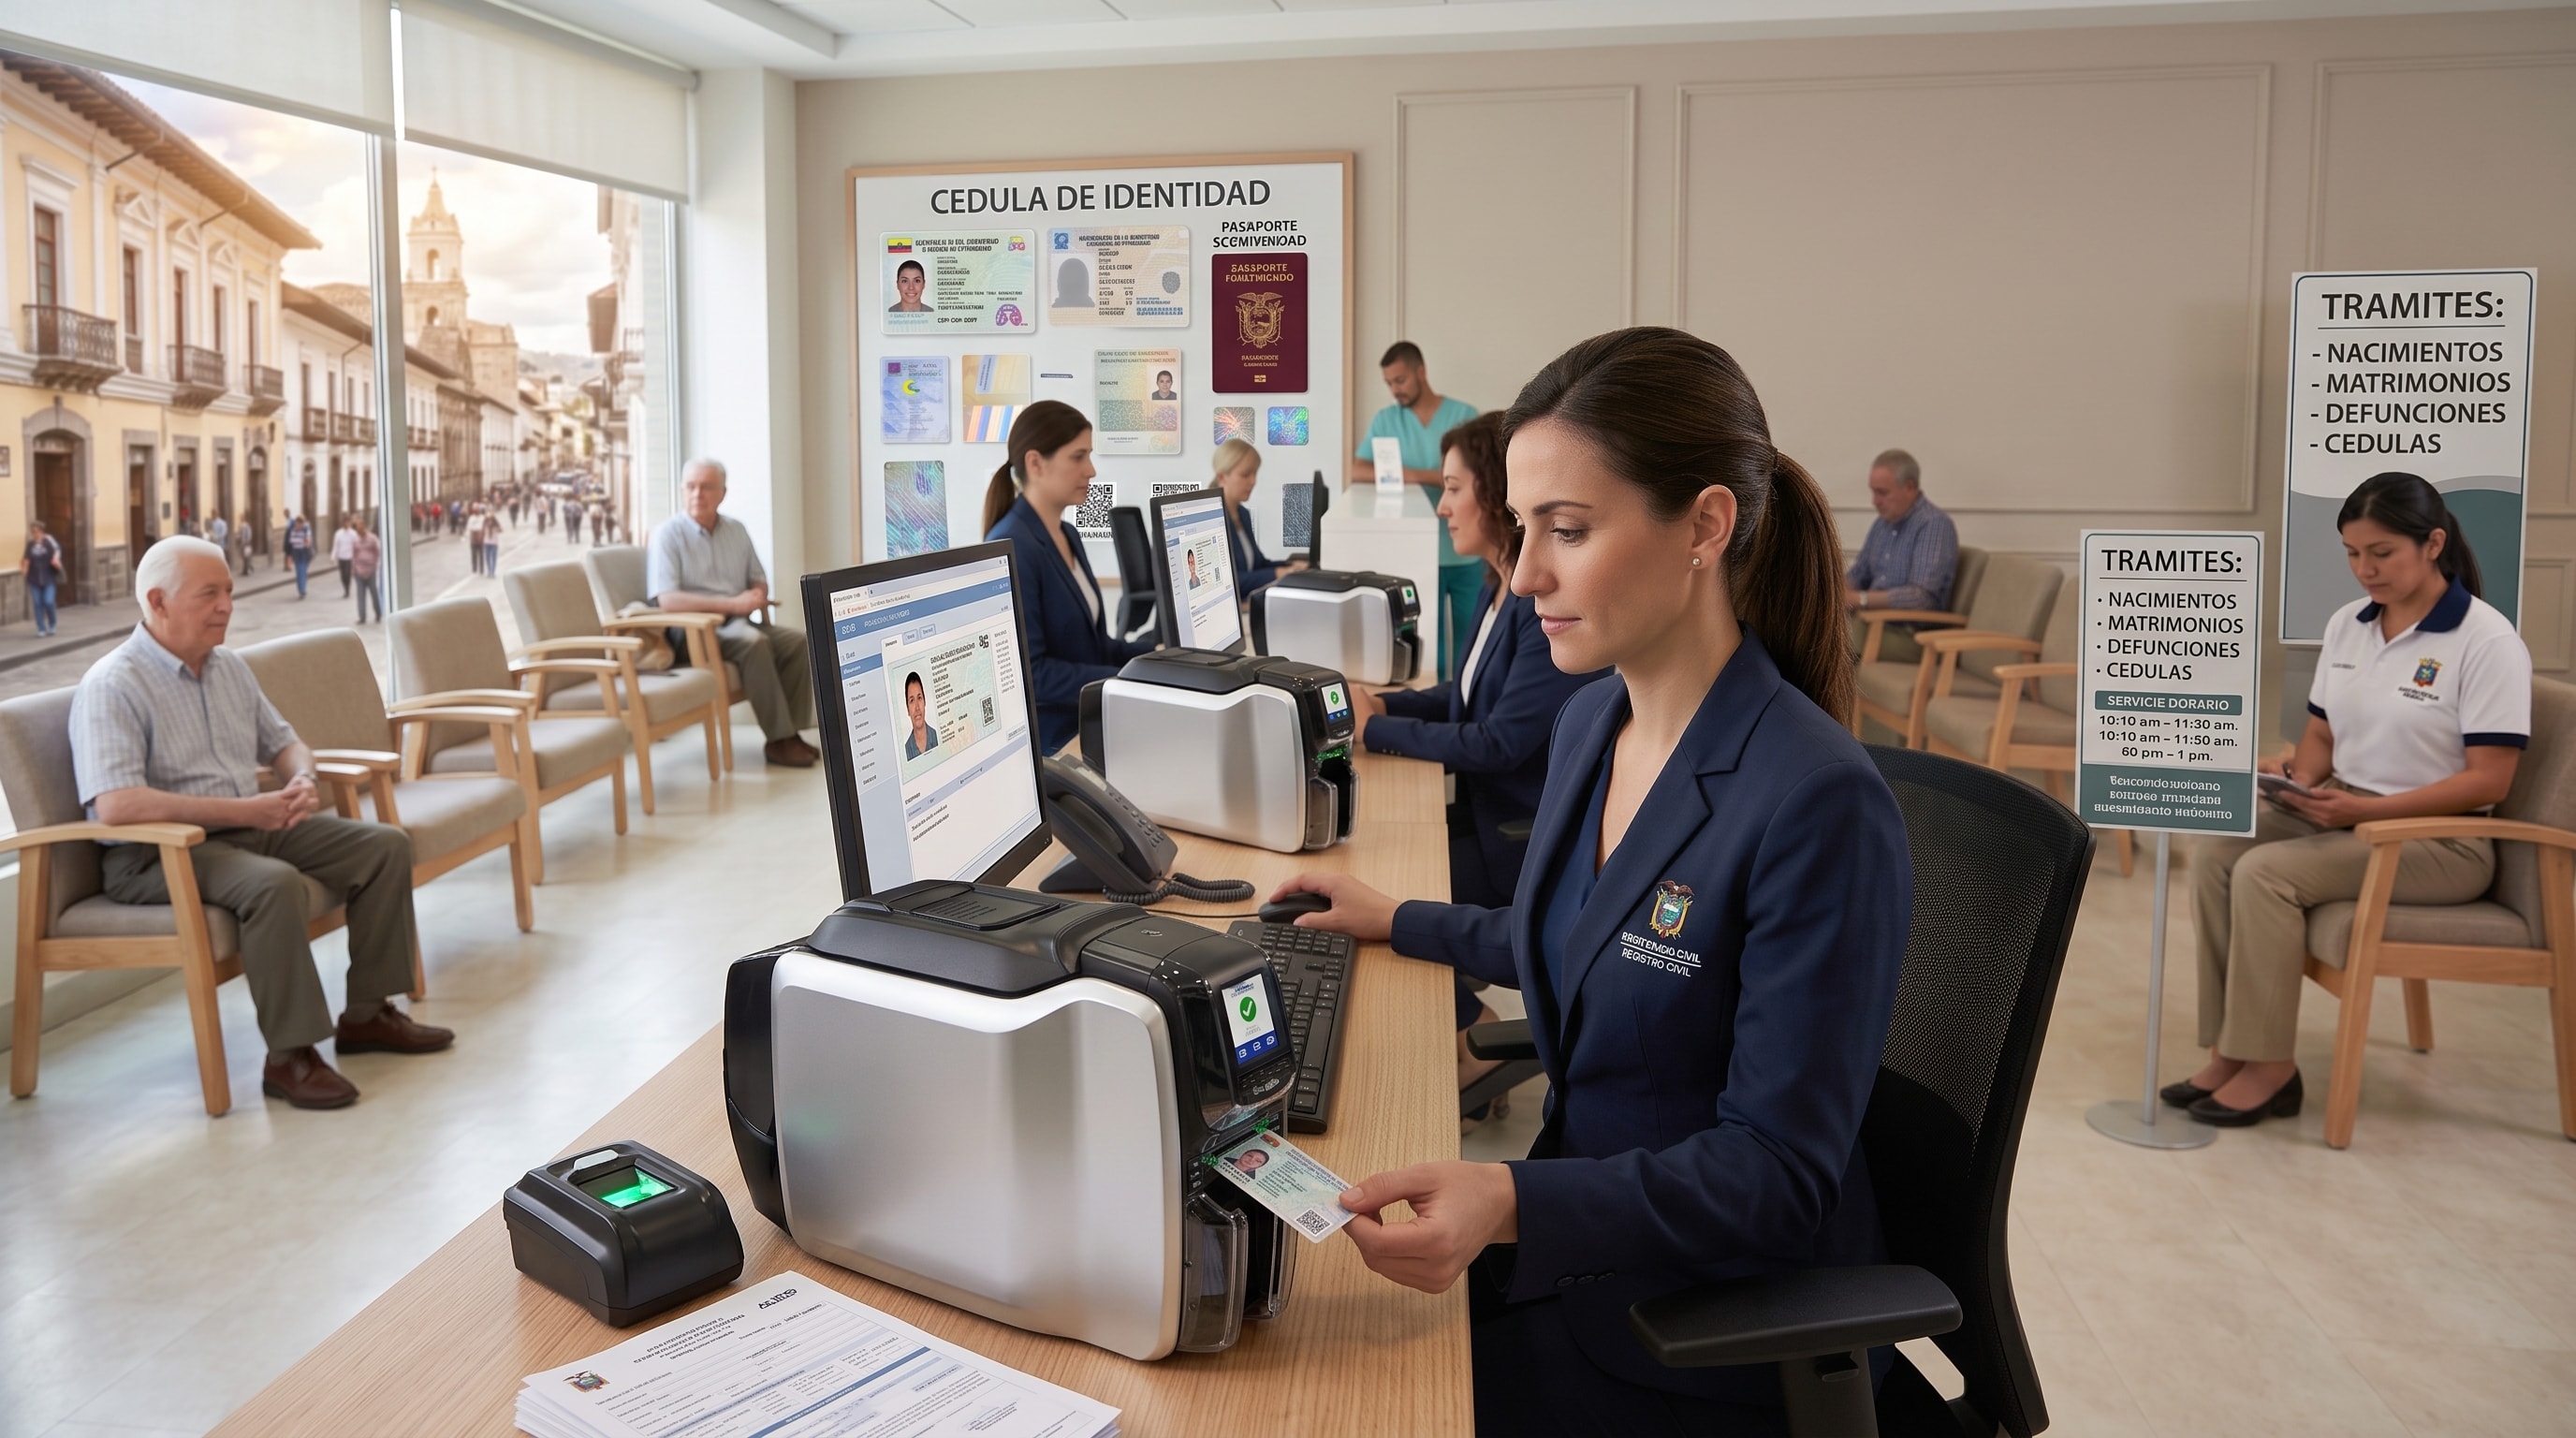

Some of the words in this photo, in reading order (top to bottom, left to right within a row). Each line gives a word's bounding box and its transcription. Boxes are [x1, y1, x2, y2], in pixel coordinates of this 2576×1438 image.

[930, 186, 1048, 214] CEDULA
[1057, 184, 1095, 211] DE
[1105, 180, 1271, 210] IDENTIDAD
[2321, 291, 2504, 320] TRAMITES:
[2327, 342, 2504, 363] NACIMIENTOS
[2326, 372, 2511, 393] MATRIMONIOS
[2326, 403, 2507, 424] DEFUNCIONES
[2324, 433, 2442, 454] CEDULAS
[2101, 550, 2242, 573] TRAMITES:
[2108, 592, 2237, 609] NACIMIENTOS
[2108, 615, 2244, 634] MATRIMONIOS
[2108, 638, 2240, 658] DEFUNCIONES
[2106, 662, 2192, 680] CEDULAS
[2107, 696, 2166, 709] SERVICIE
[2168, 697, 2230, 711] DORARIO
[2100, 715, 2136, 726] 10:10
[2140, 718, 2160, 727] am
[2174, 718, 2211, 730] 11:30
[2214, 722, 2238, 731] am.
[2100, 730, 2136, 741] 10:10
[2140, 733, 2160, 743] am
[2174, 734, 2211, 746] 11:50
[2214, 737, 2238, 747] am.
[2142, 749, 2163, 760] pm
[2177, 750, 2184, 760] 1
[2188, 752, 2214, 763] pm.
[1621, 947, 1664, 969] REGISTRO
[1666, 962, 1691, 977] CIVIL
[1676, 949, 1702, 963] CIVIL
